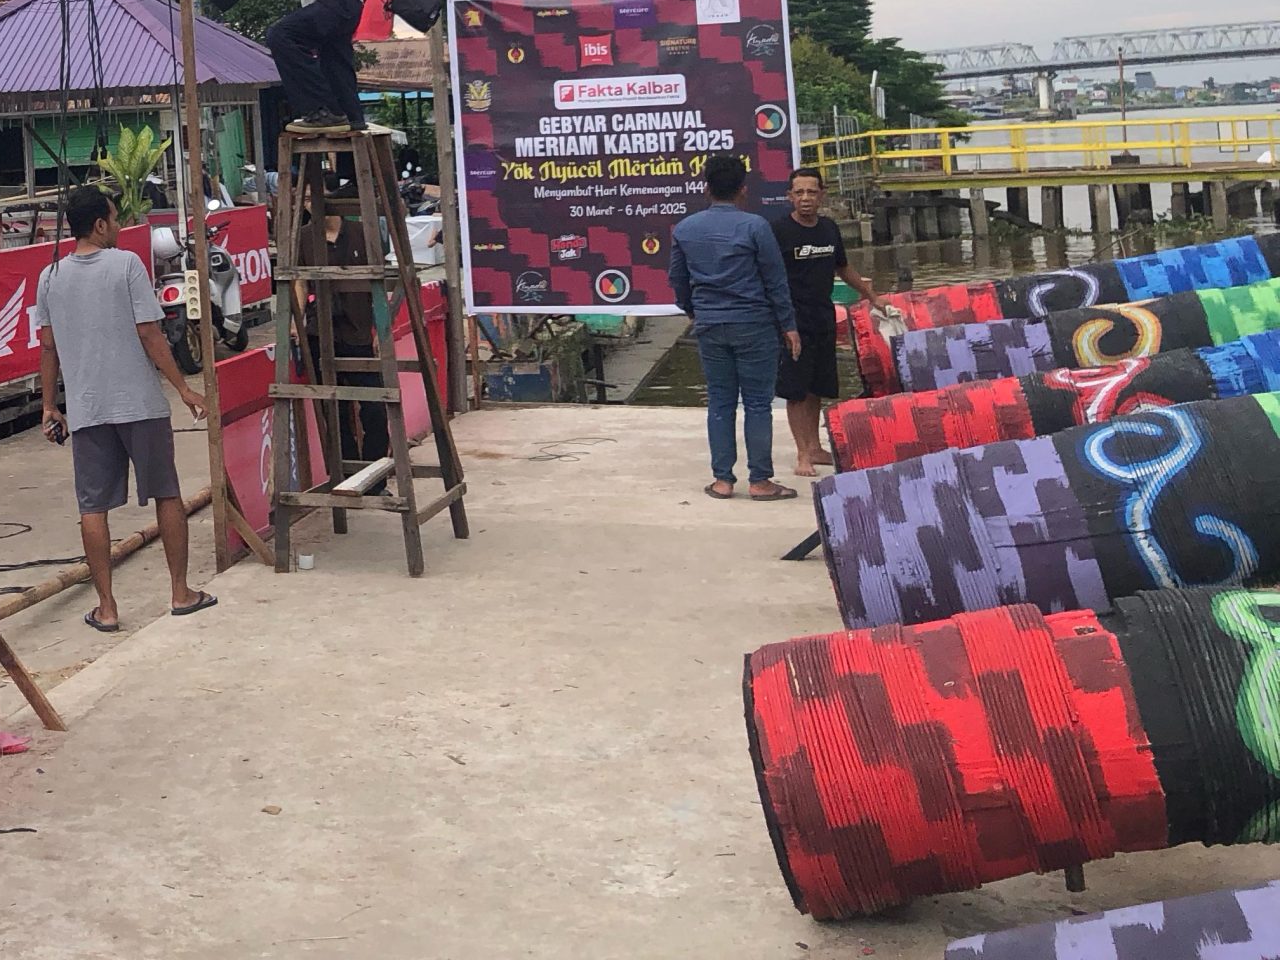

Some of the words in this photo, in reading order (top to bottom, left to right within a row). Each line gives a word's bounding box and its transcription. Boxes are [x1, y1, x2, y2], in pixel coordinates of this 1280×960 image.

[584, 42, 609, 57] ibis
[578, 84, 623, 98] Fakta
[626, 81, 680, 96] Kalbar
[539, 114, 607, 135] GEBYAR
[611, 110, 707, 132] CARNAVAL
[515, 135, 599, 158] MERIAM
[604, 132, 678, 155] KARBIT
[683, 129, 734, 151] 2025
[534, 186, 594, 200] Menyambut
[595, 184, 617, 197] Hari
[620, 184, 682, 198] Kemenangan
[570, 206, 584, 217] 30
[586, 205, 615, 217] Maret
[625, 204, 632, 216] 6
[635, 203, 658, 218] April
[660, 203, 687, 215] 2025
[229, 248, 272, 286] HON
